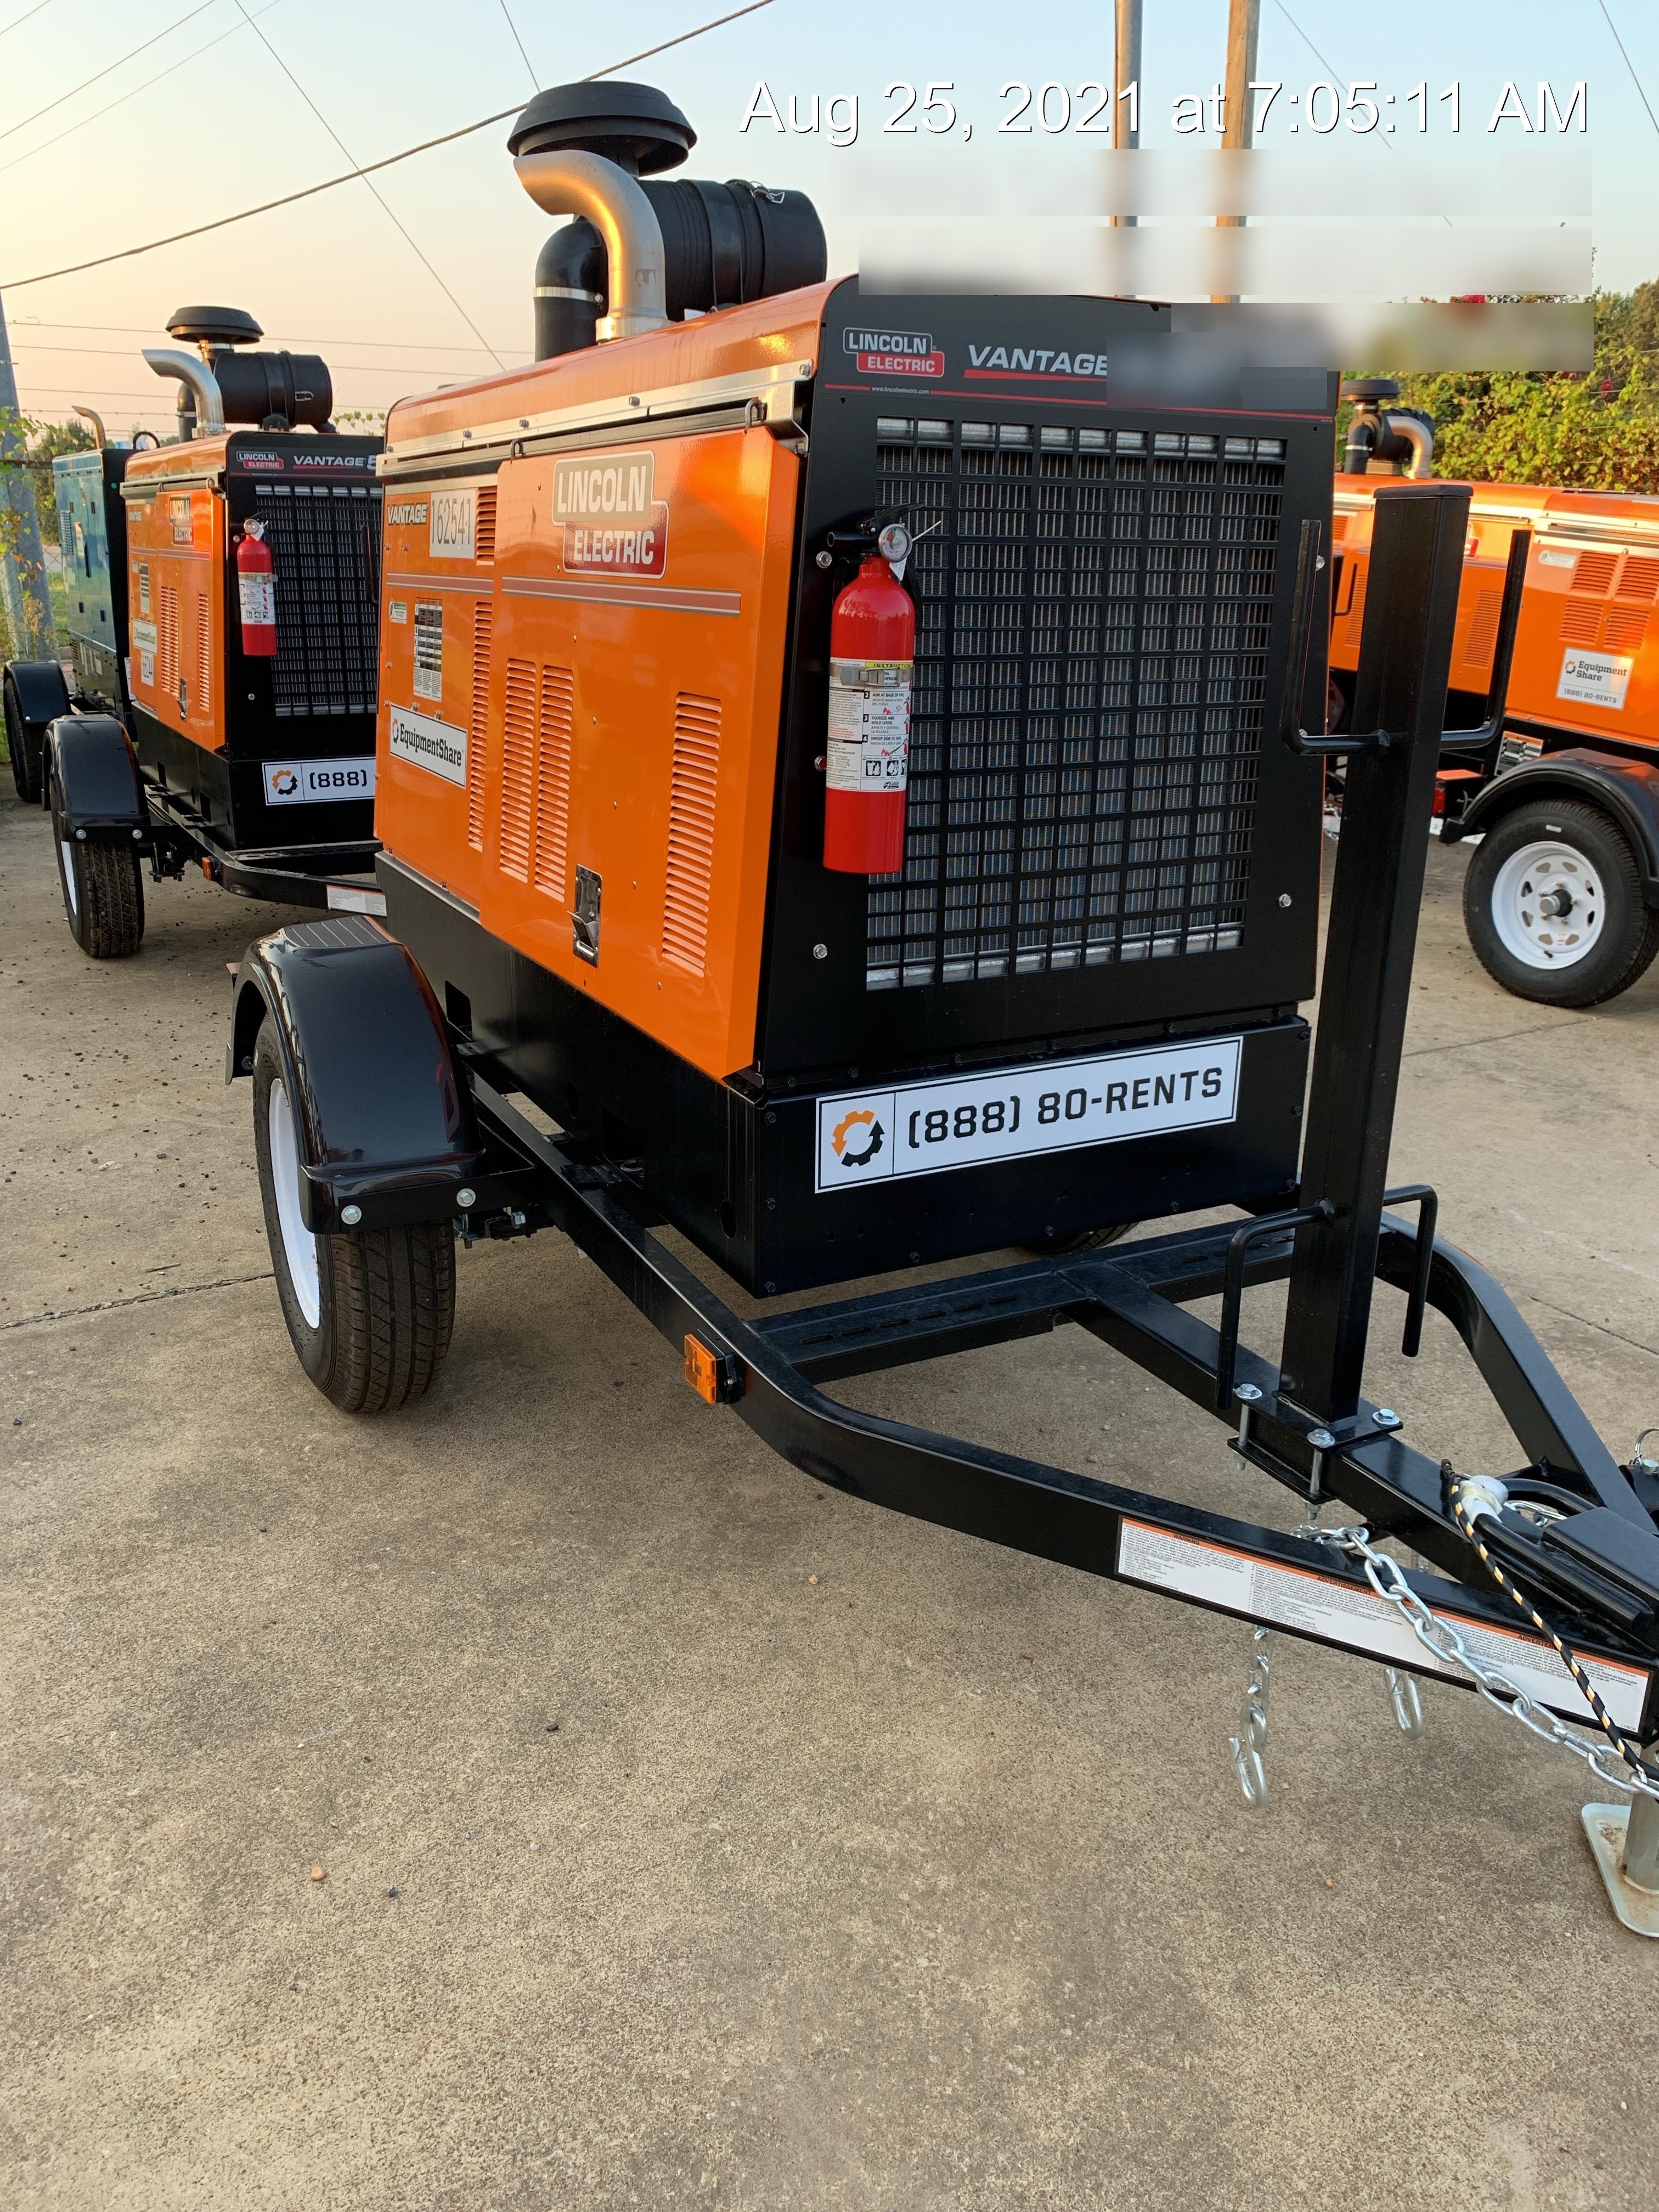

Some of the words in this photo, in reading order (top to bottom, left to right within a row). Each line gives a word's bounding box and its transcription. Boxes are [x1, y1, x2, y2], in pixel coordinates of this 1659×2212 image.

[848, 332, 927, 355] LINCOLN
[867, 356, 935, 373] ELECTRIC
[871, 386, 929, 394] www.lincolnelectric.com
[239, 453, 275, 461] LINCOLN
[293, 455, 364, 466] VANTAGE
[557, 465, 647, 514] LINCOLN
[387, 503, 428, 525] VANTAGE
[431, 498, 471, 545] 162541
[573, 530, 655, 565] ELECTRIC
[1576, 670, 1602, 681] Share
[1578, 661, 1627, 676] Equipment
[1584, 691, 1617, 703] 80-RENTS
[399, 723, 461, 767] EquipmentShare
[309, 769, 368, 790] (888)
[908, 1096, 1020, 1149] (888)
[1037, 1067, 1223, 1124] 80-RENTS
[1173, 1533, 1200, 1545] WARNING
[1317, 1577, 1372, 1595] ADVERTISSEMENT
